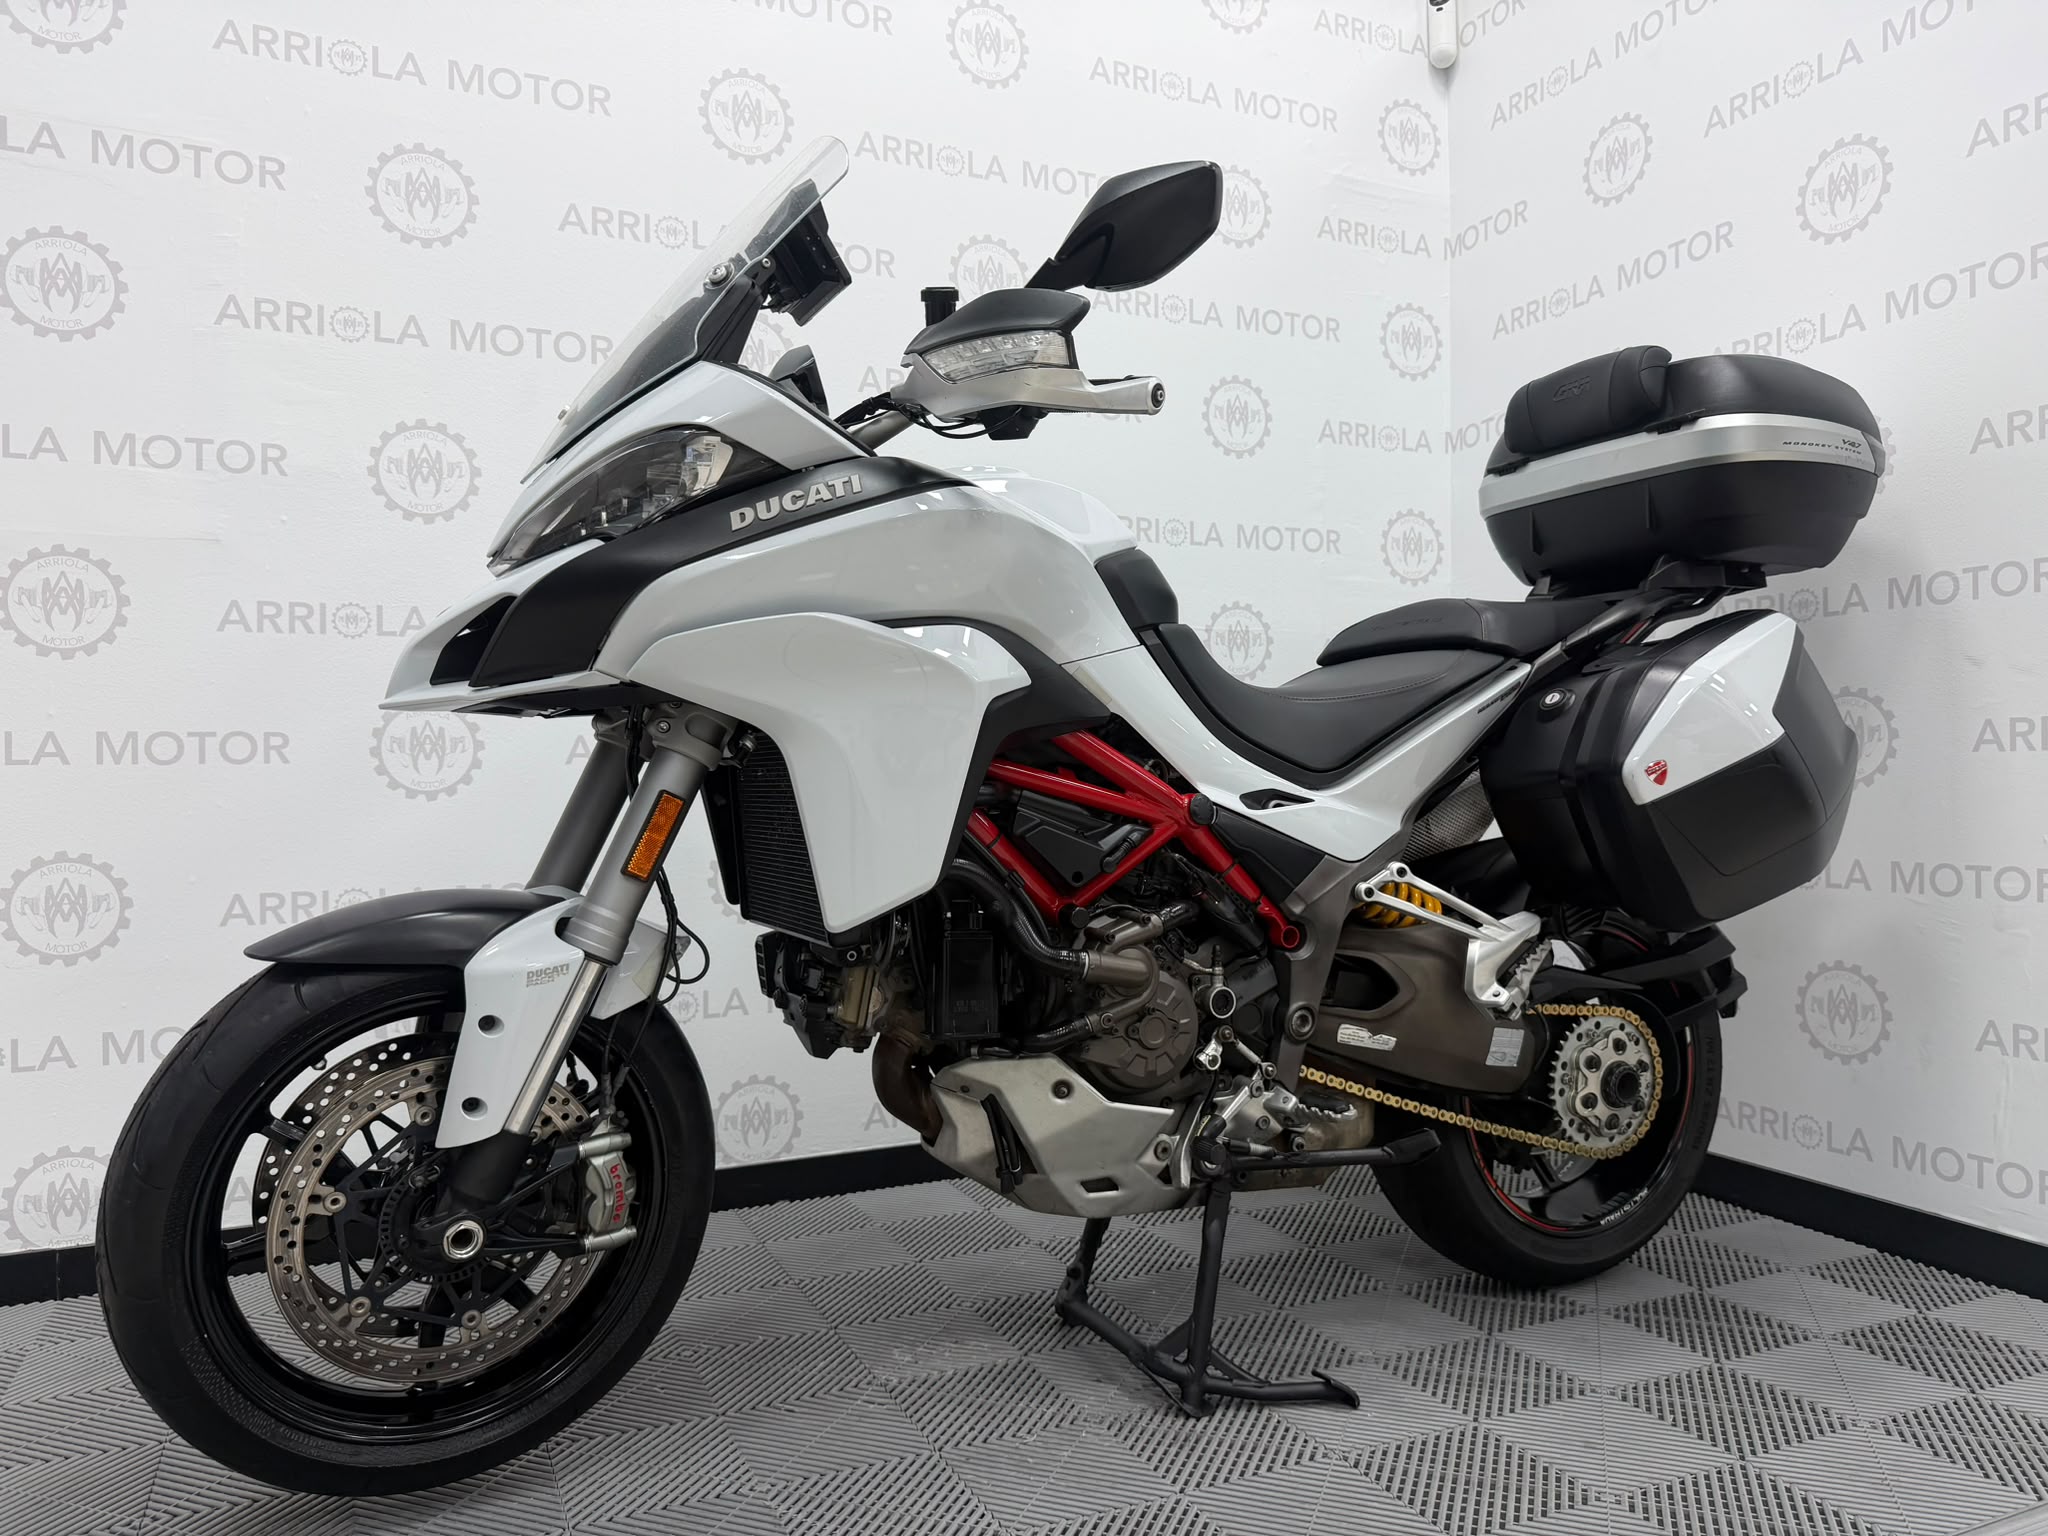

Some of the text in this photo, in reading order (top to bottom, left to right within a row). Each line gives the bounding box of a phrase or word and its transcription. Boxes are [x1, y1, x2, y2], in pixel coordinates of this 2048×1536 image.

[38, 25, 82, 42] MOTOR
[1458, 0, 1526, 48] OTOR
[211, 18, 612, 118] ARRIOLA MOTOR
[1088, 56, 1339, 134] ARRIOLA MOTOR
[1490, 46, 1604, 132] ARRIOLA
[1703, 37, 1865, 139] ARRIOLA
[91, 129, 287, 192] MOTOR
[399, 152, 447, 171] ARRIOLA
[853, 130, 1107, 200] ARRIOLA MOT
[34, 238, 88, 257] ARRIOLA
[403, 223, 442, 237] MOTOR
[1316, 199, 1529, 262] ARRIOLA MOTOR
[1491, 220, 1734, 341] ARRIOLA MOTOR
[39, 314, 83, 329] MOTOR
[213, 293, 614, 366] ARRIOLA MOTOR
[1092, 290, 1341, 344] ARRIOLA MOTOR
[93, 430, 289, 478] MOTOR
[402, 430, 448, 446] ARRIOLA
[1317, 418, 1433, 455] ARRIOLA
[406, 500, 445, 512] MOTOR
[729, 473, 864, 533] DUCATI
[1236, 523, 1342, 555] MOTOR
[35, 557, 90, 574] ARRIOLA
[41, 634, 86, 648] MOTOR
[95, 730, 291, 767] MOTOR
[409, 778, 446, 790] MOTOR
[38, 862, 93, 880] ARRIOLA
[44, 940, 89, 956] MOTOR
[526, 963, 570, 980] DUCATI
[41, 1157, 96, 1174] ARRIOLA
[609, 1163, 627, 1224] brembo
